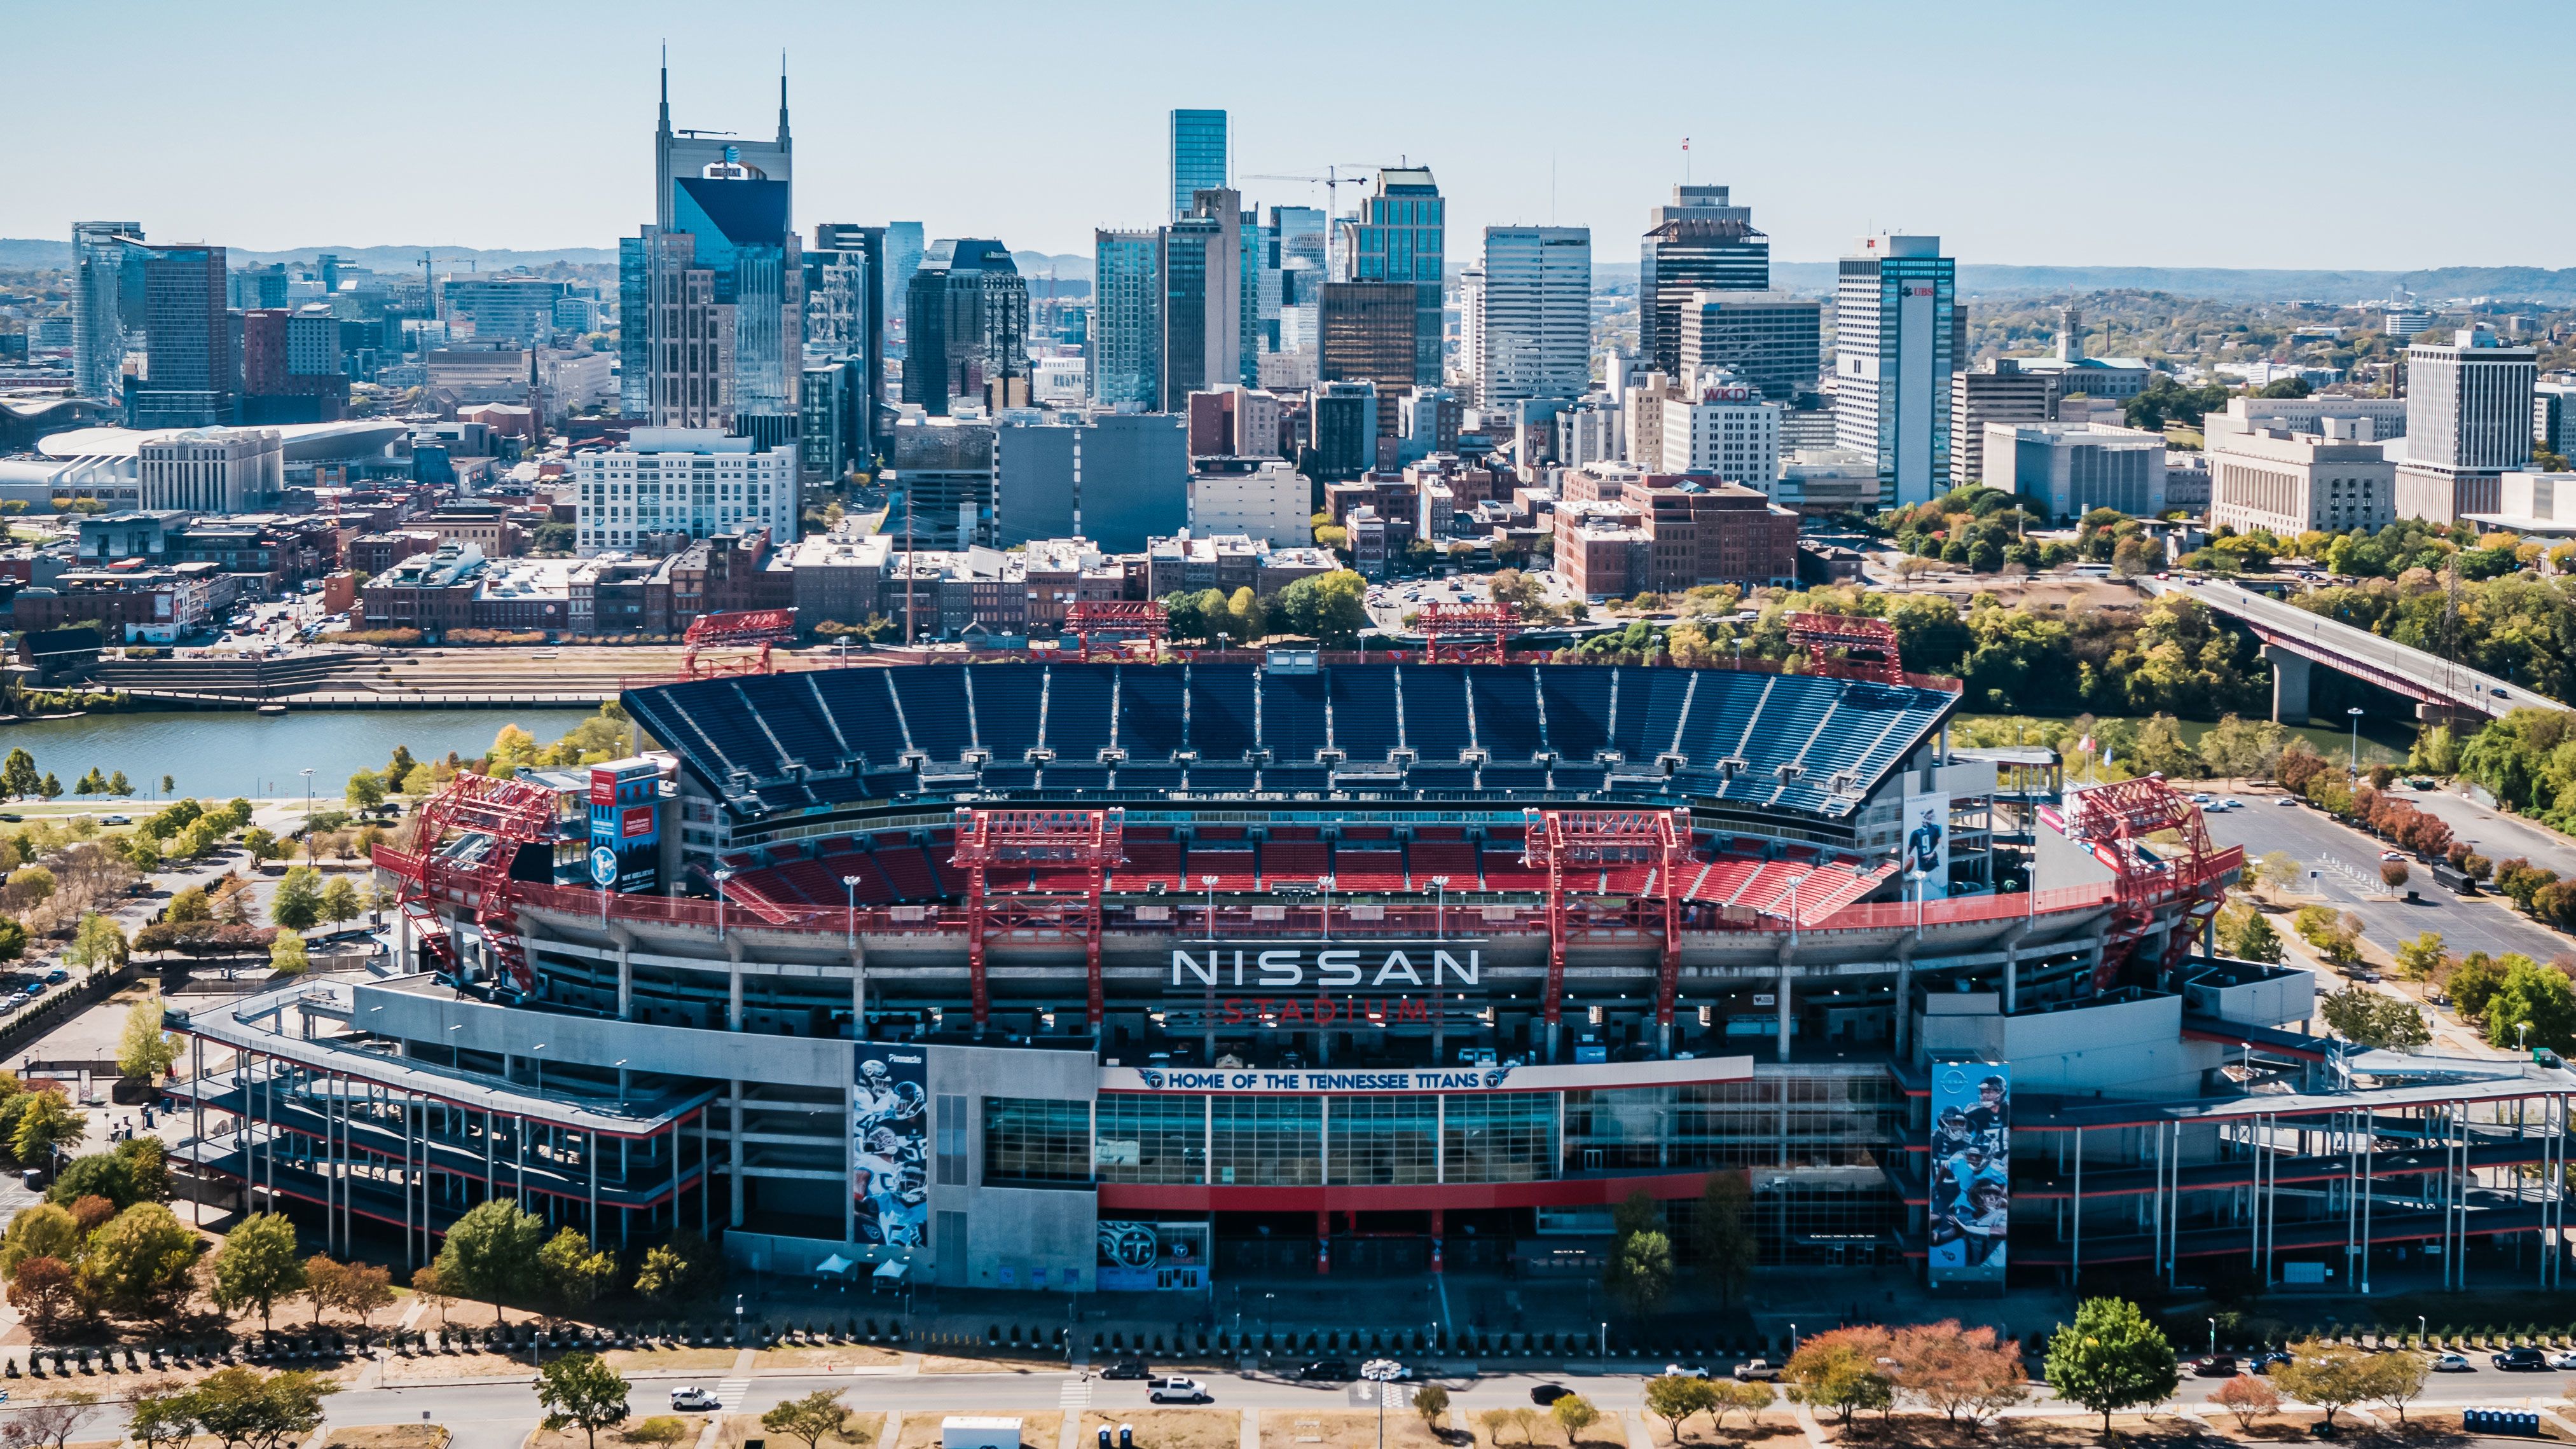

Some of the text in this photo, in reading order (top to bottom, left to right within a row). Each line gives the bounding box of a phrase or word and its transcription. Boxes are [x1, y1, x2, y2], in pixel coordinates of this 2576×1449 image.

[1913, 287, 1934, 296] UBS
[1922, 834, 1930, 854] 9
[1172, 949, 1479, 985] NISSAN
[1223, 998, 1428, 1024] STADIUM
[1169, 1073, 1479, 1089] HOME OF THE TENNESSEE TITANS
